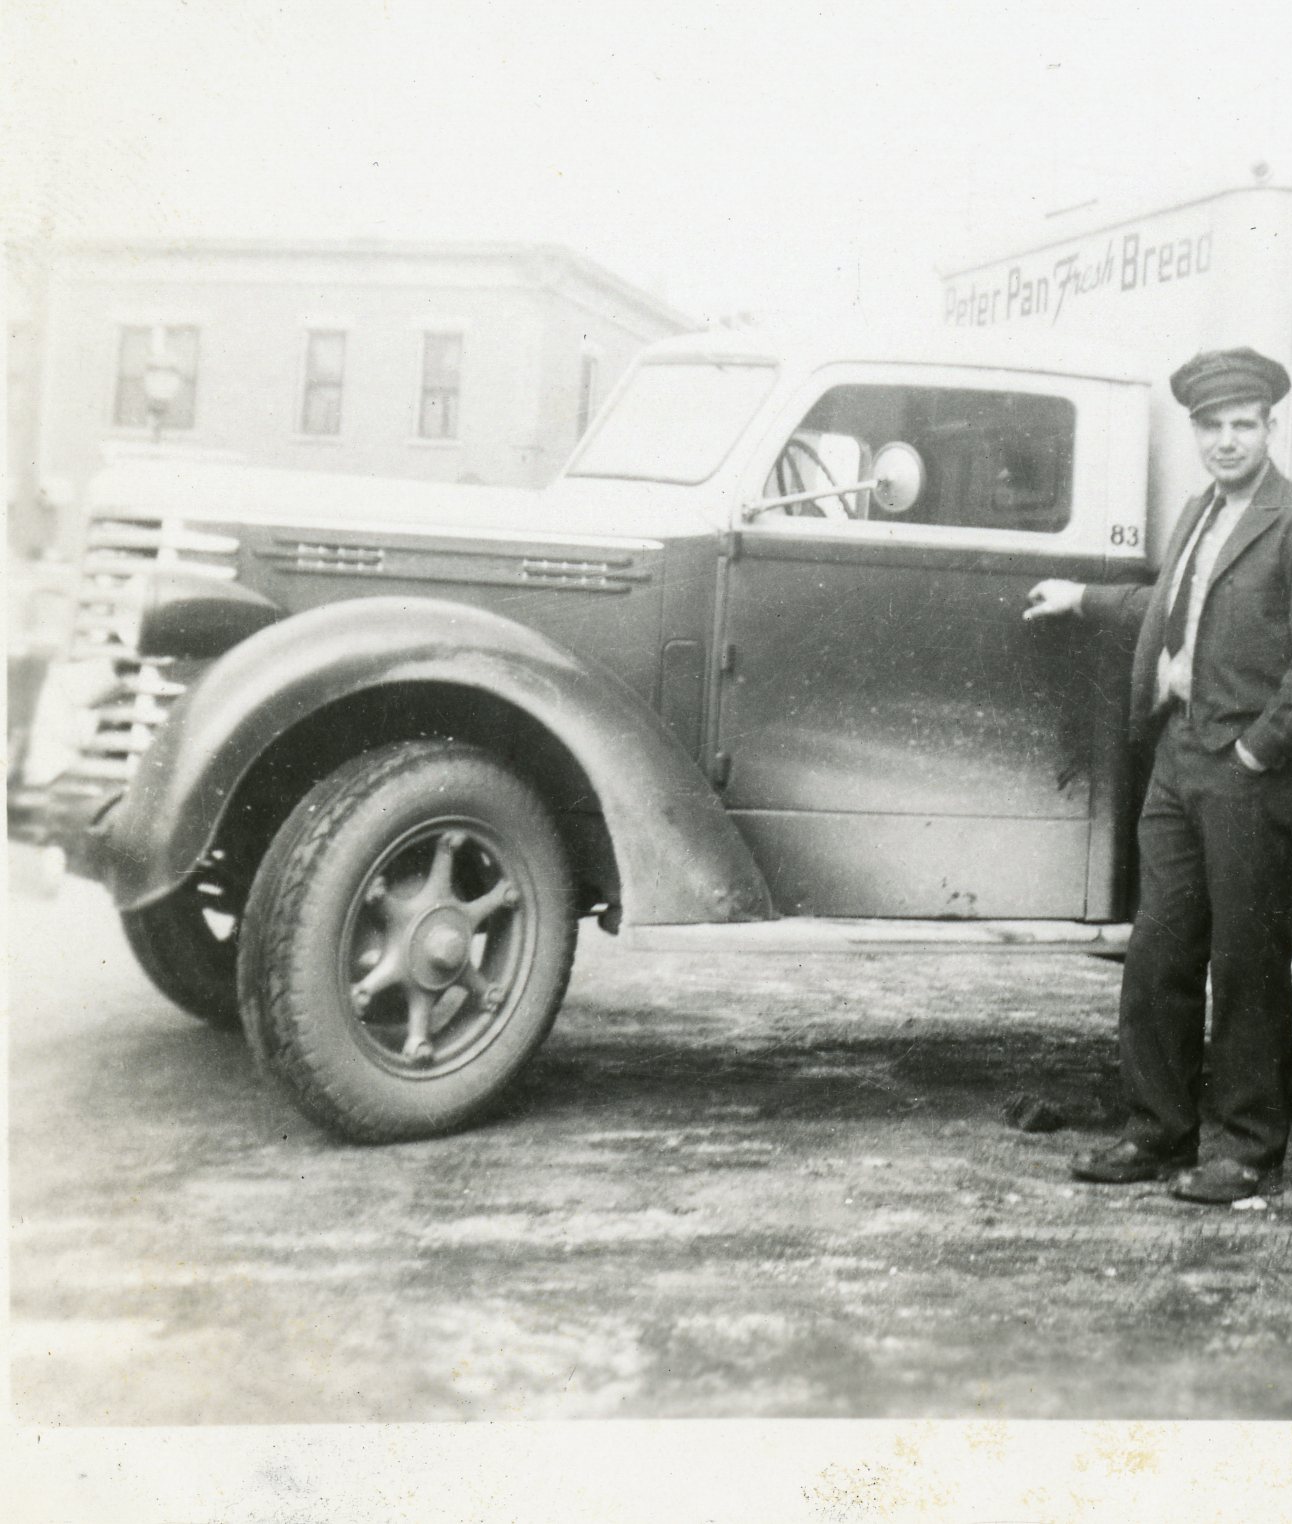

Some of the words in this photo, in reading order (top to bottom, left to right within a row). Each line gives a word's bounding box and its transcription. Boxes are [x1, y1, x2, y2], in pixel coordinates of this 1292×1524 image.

[944, 284, 1001, 327] Peter
[1007, 266, 1049, 320] Pan
[1053, 239, 1115, 326] Fresh
[1121, 231, 1212, 292] Bread
[1111, 524, 1138, 547] 83
